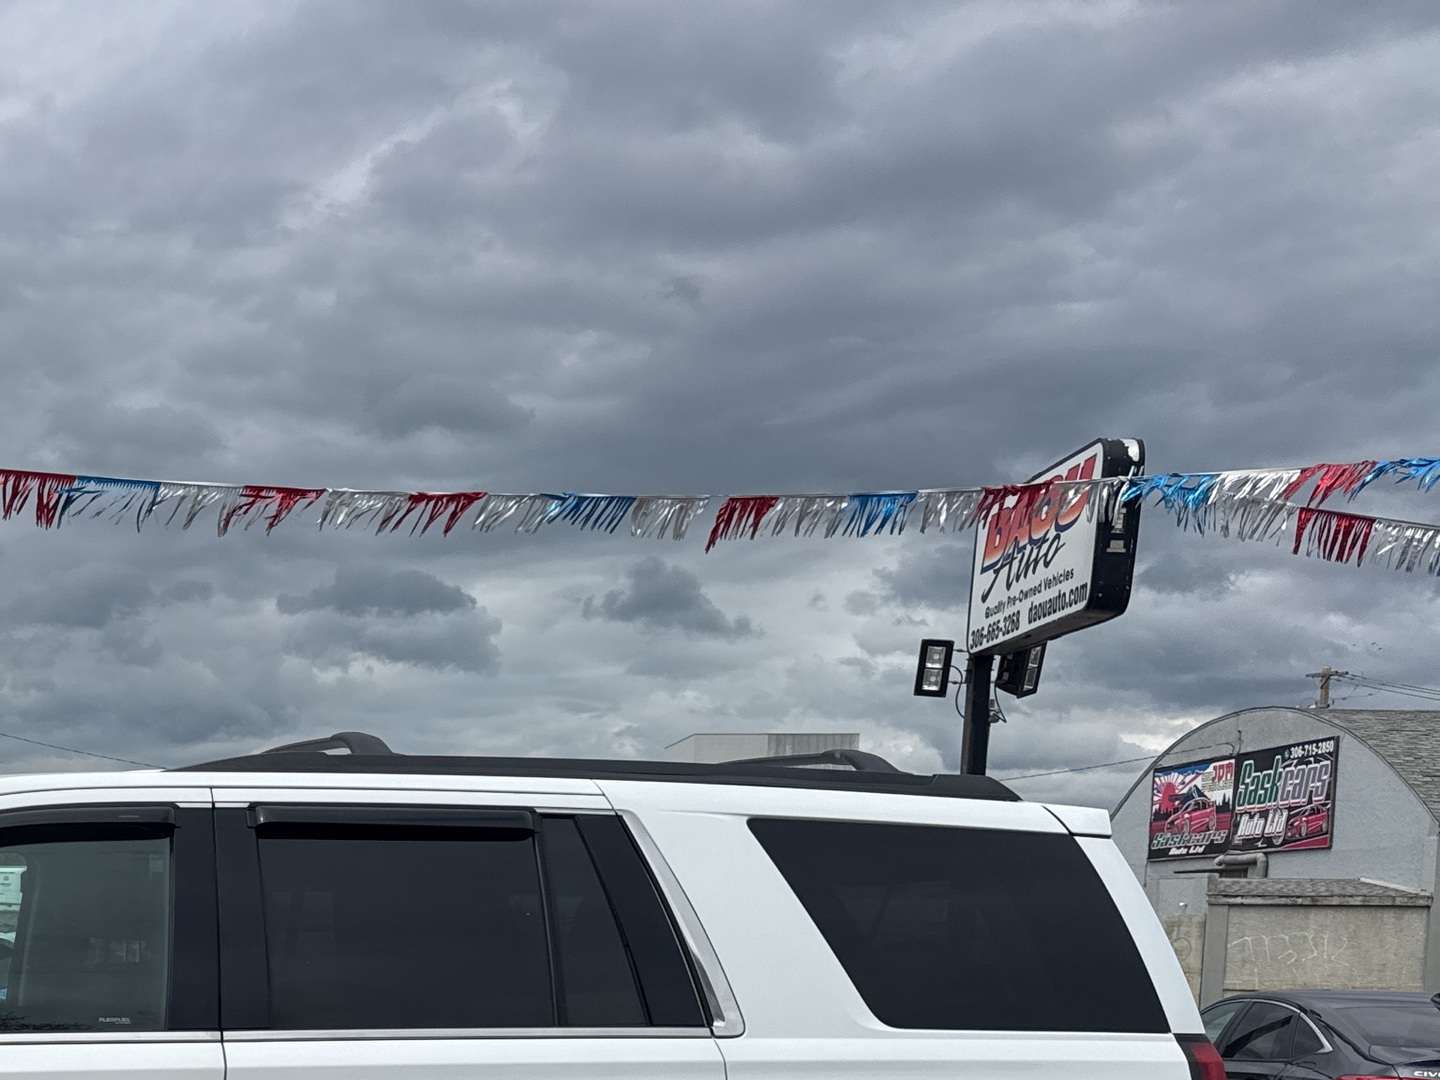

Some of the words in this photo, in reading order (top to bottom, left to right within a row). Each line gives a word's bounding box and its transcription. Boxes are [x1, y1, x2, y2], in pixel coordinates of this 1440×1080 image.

[980, 453, 1098, 575] DAOU
[981, 533, 1066, 604] Auto
[985, 599, 1006, 619] Quality
[1007, 580, 1042, 608] Pre-Owned
[1044, 568, 1074, 591] Vehicles
[1028, 582, 1088, 625] daouauto.com
[1237, 812, 1265, 839] Auto
